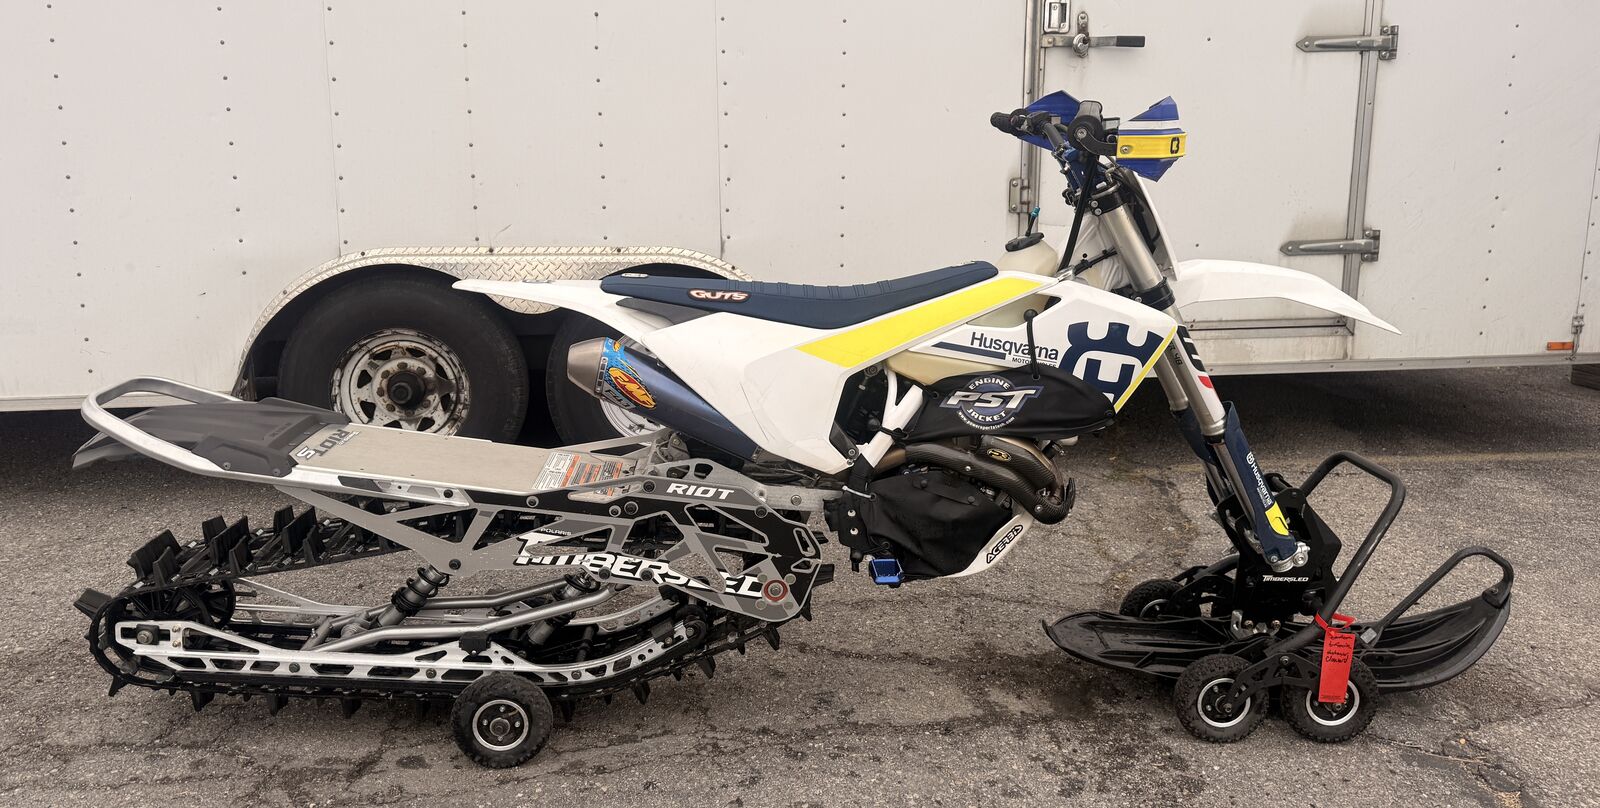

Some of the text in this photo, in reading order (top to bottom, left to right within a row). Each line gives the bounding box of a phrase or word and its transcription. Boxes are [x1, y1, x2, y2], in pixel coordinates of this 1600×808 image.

[689, 289, 749, 301] GUTS
[968, 377, 1011, 390] ENGINE
[946, 389, 1037, 409] PST
[966, 408, 1007, 422] JACKET
[666, 482, 735, 500] RIOT
[1251, 463, 1273, 506] Husqvarna
[540, 527, 572, 536] POLARIS
